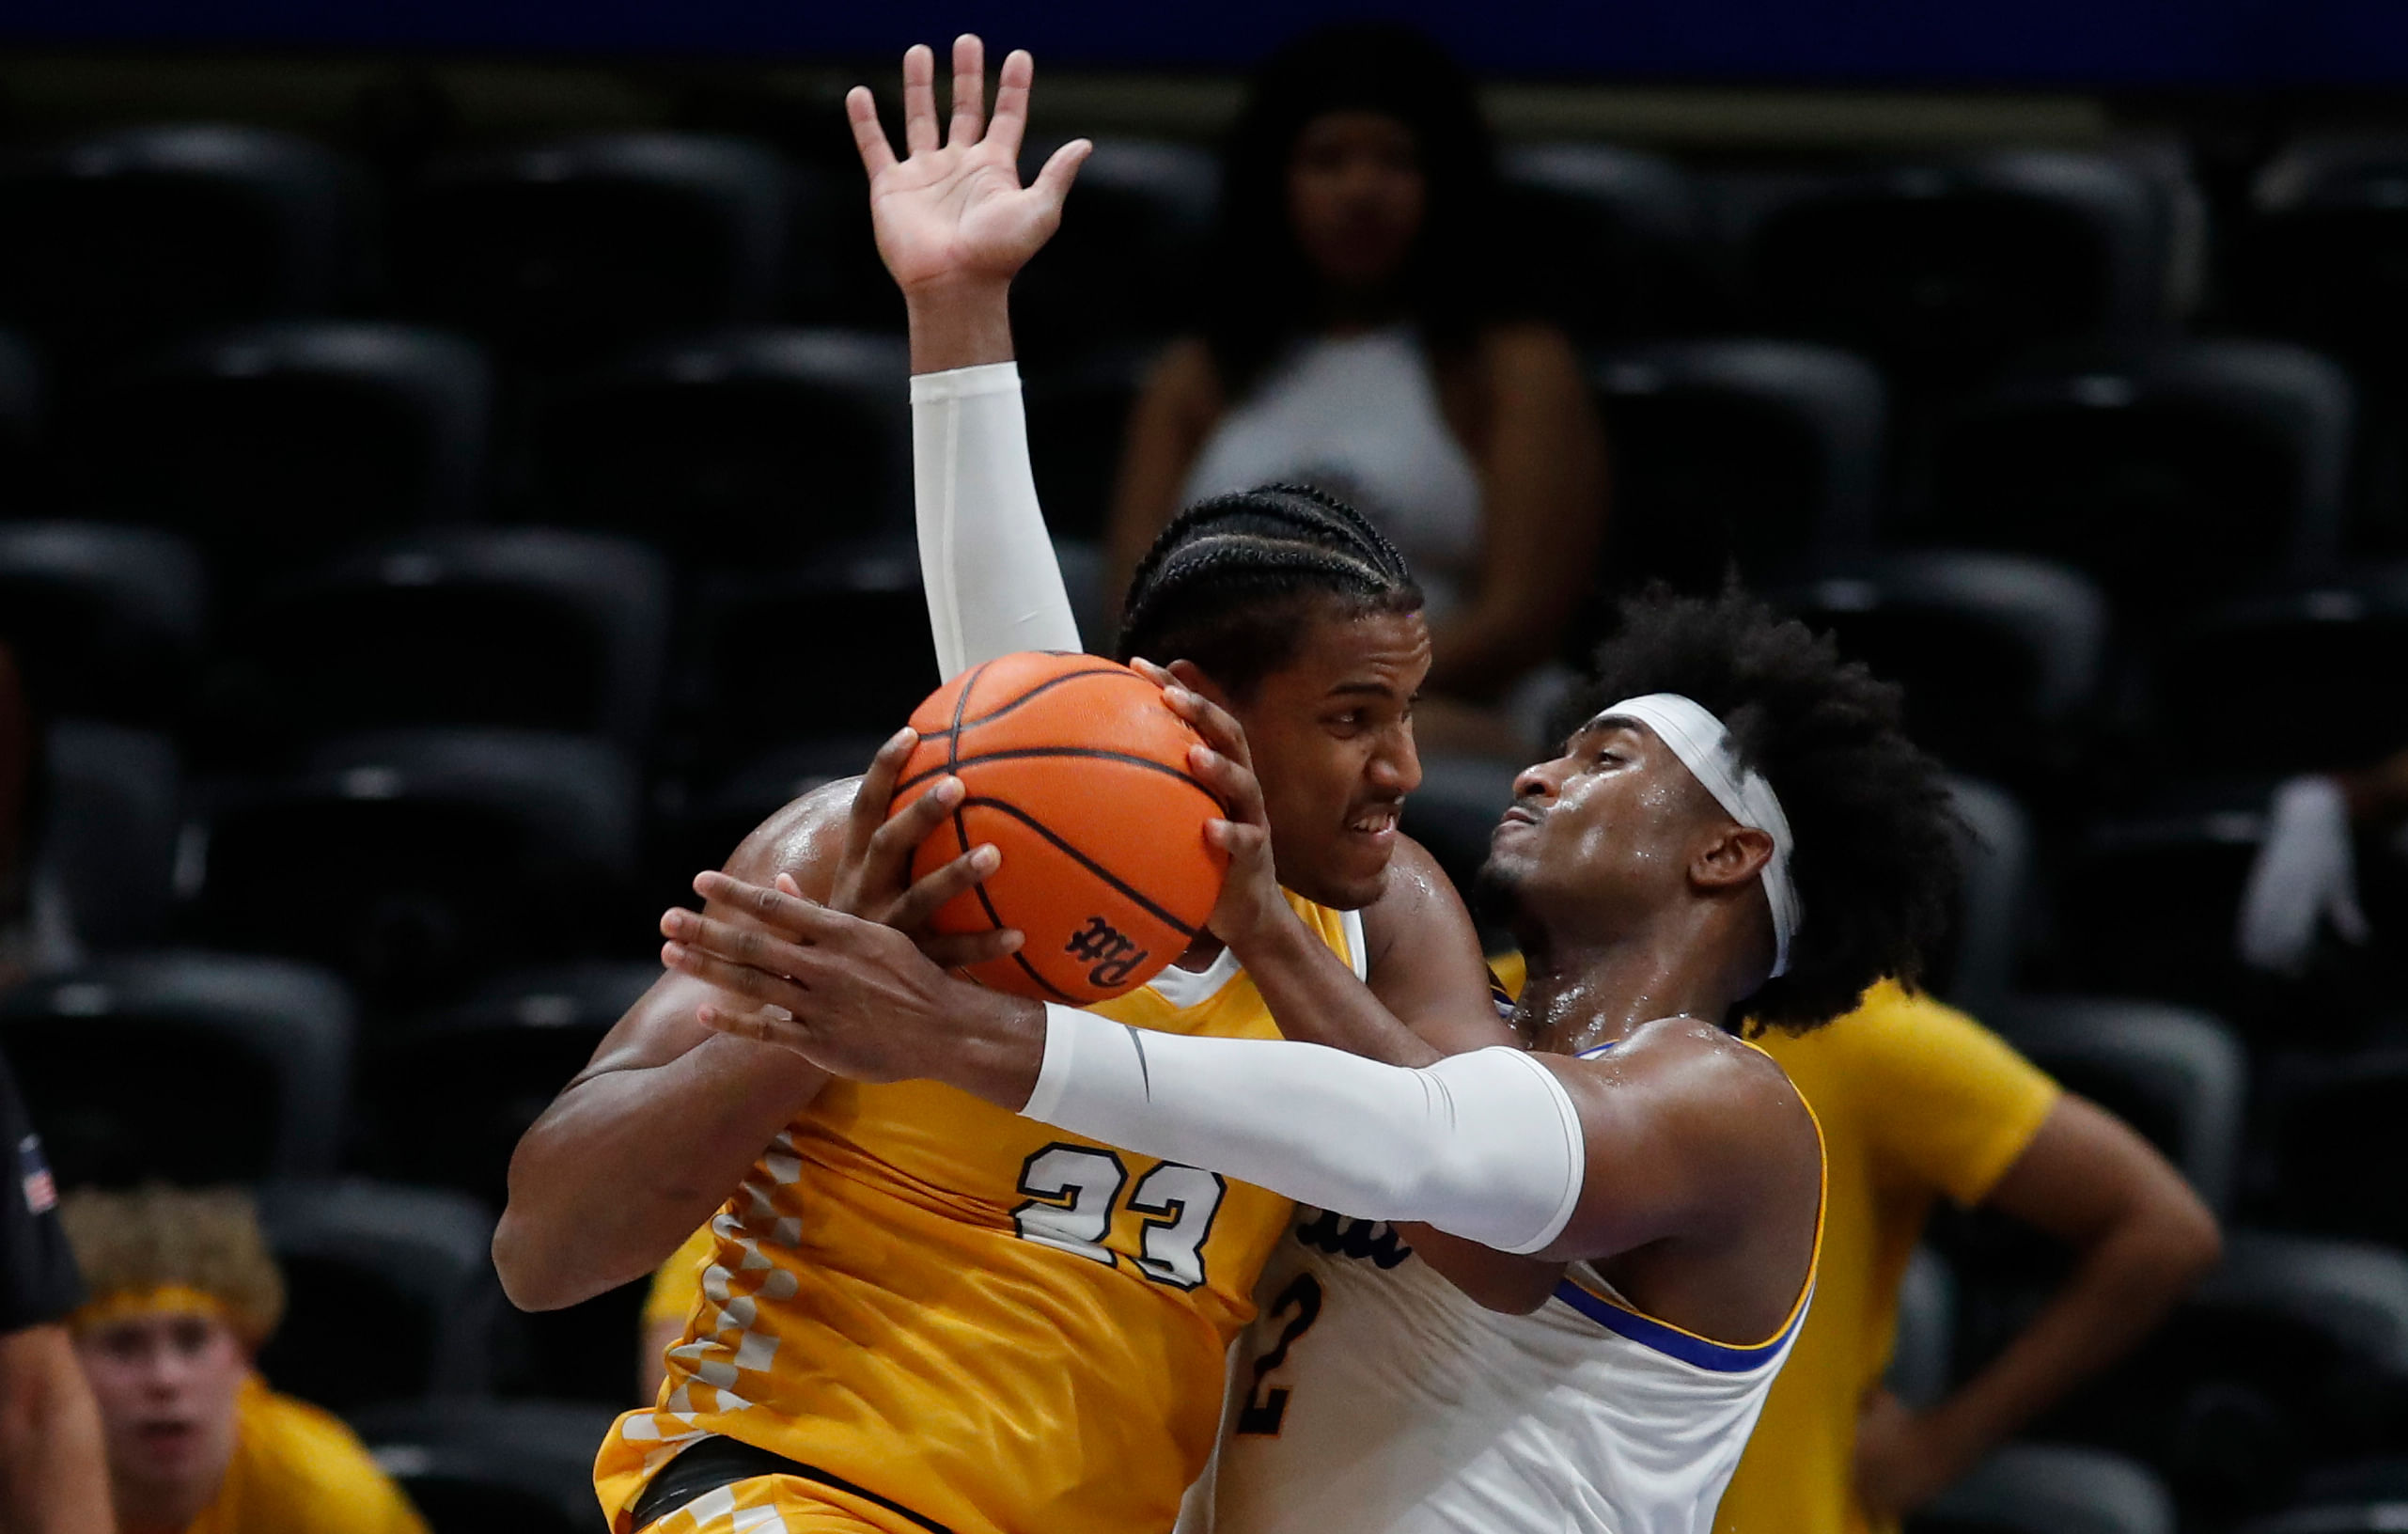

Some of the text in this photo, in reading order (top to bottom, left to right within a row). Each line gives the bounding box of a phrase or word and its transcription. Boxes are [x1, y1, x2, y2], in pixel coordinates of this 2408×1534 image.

[1065, 917, 1149, 987] Pitt
[1009, 1142, 1227, 1292] 23
[1236, 1272, 1321, 1435] 2
